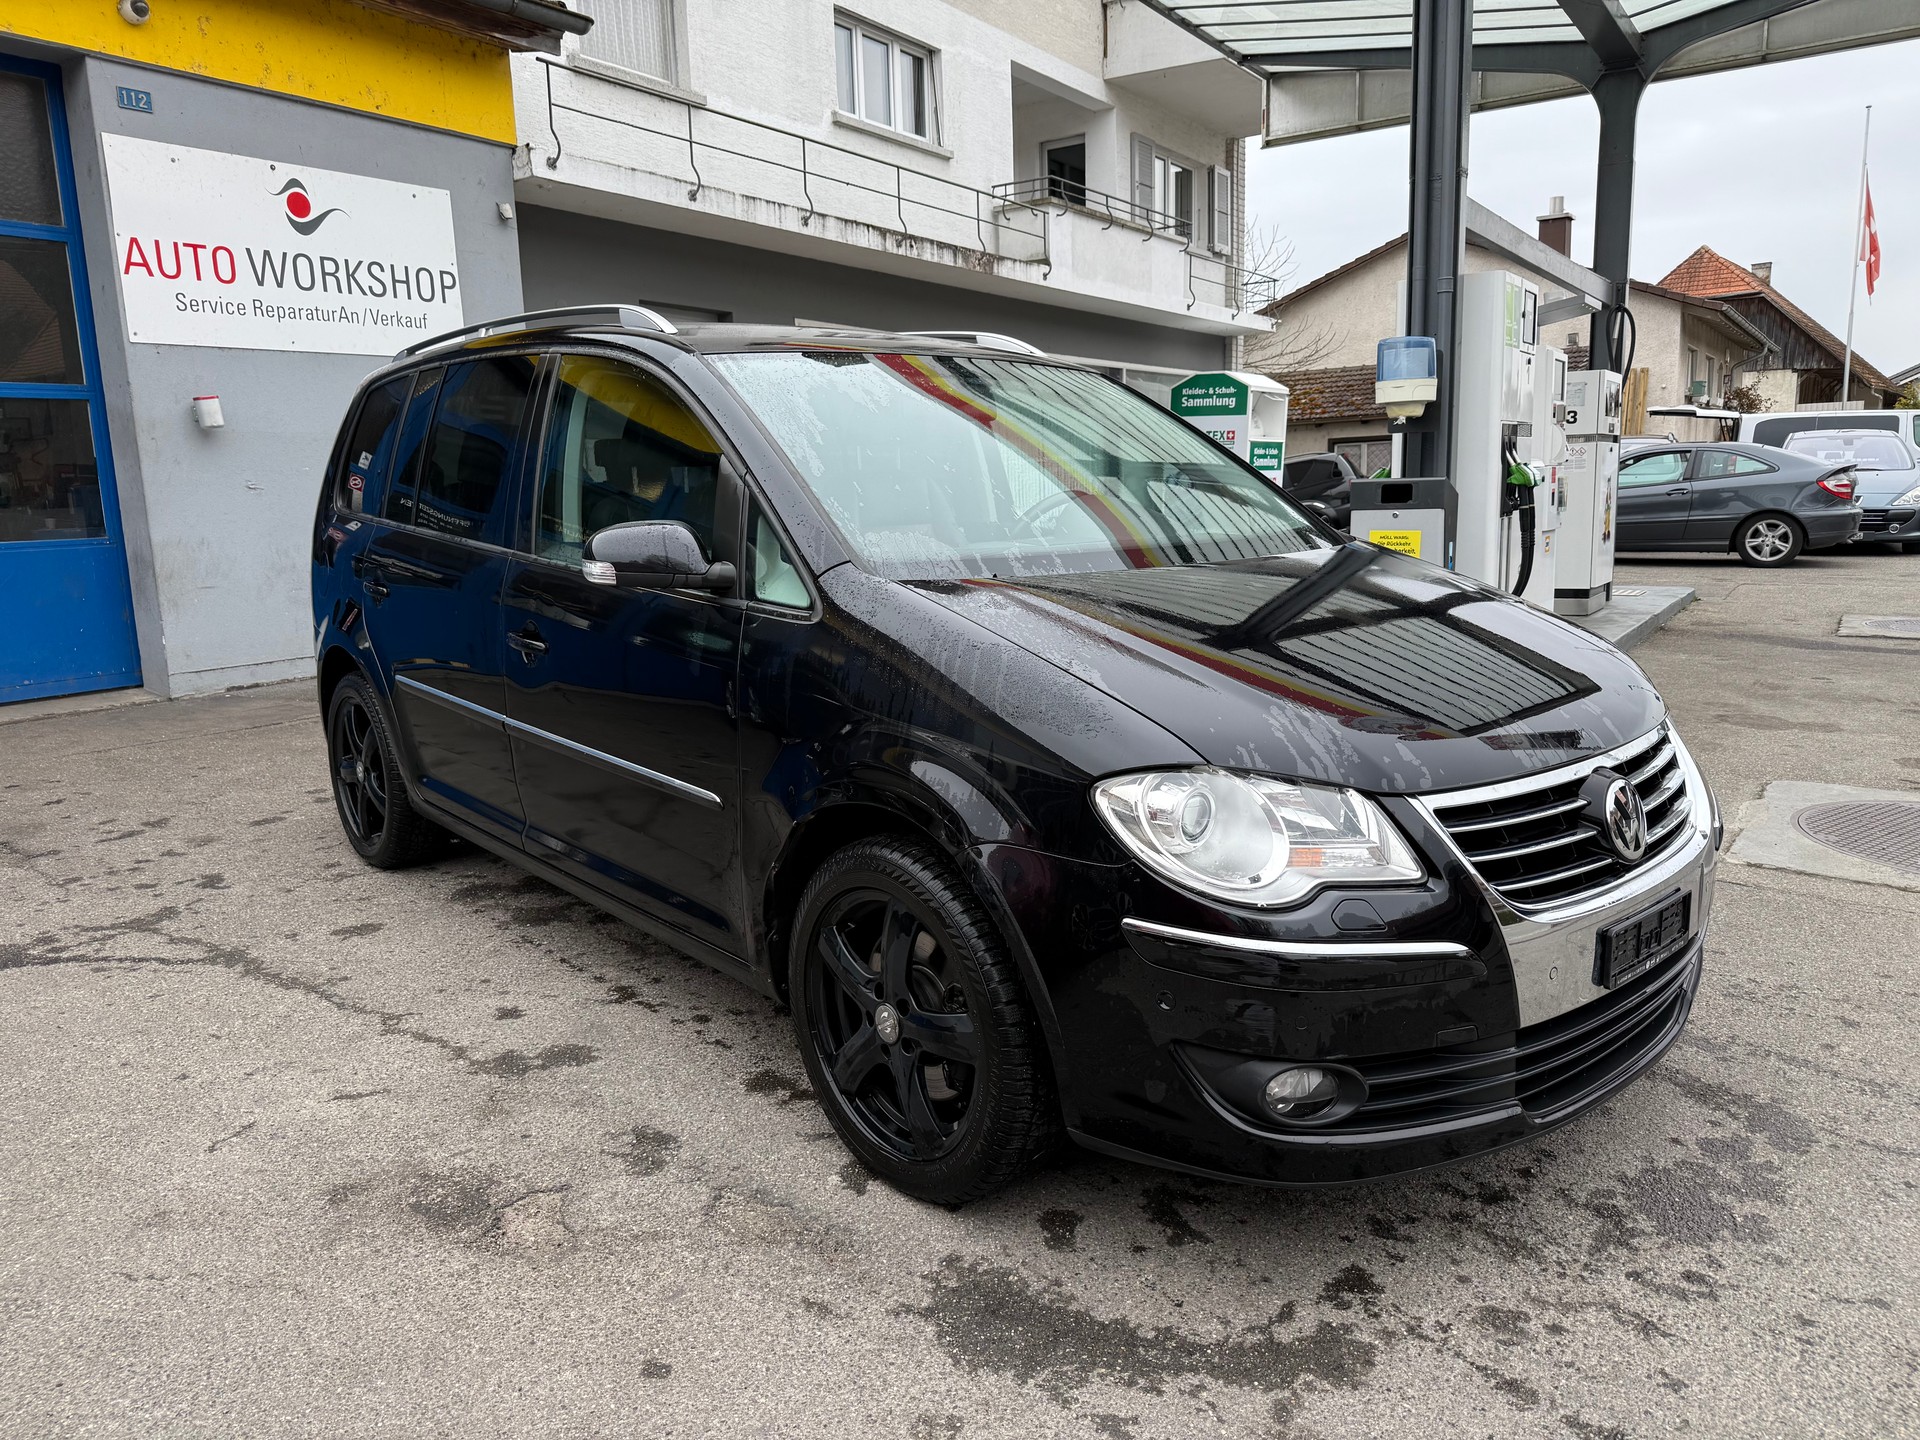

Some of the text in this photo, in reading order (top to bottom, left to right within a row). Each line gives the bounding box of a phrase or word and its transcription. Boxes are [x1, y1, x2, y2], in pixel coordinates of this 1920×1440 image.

[122, 90, 148, 109] 112
[124, 236, 457, 304] AUTO WORKSHOP
[175, 292, 247, 316] Service
[1182, 387, 1208, 395] Kleider-
[1215, 386, 1237, 394] Schuh-
[1181, 395, 1236, 408] Sammlung
[1565, 410, 1578, 425] 3
[1205, 430, 1225, 441] TEX
[1253, 455, 1278, 469] Sammlung
